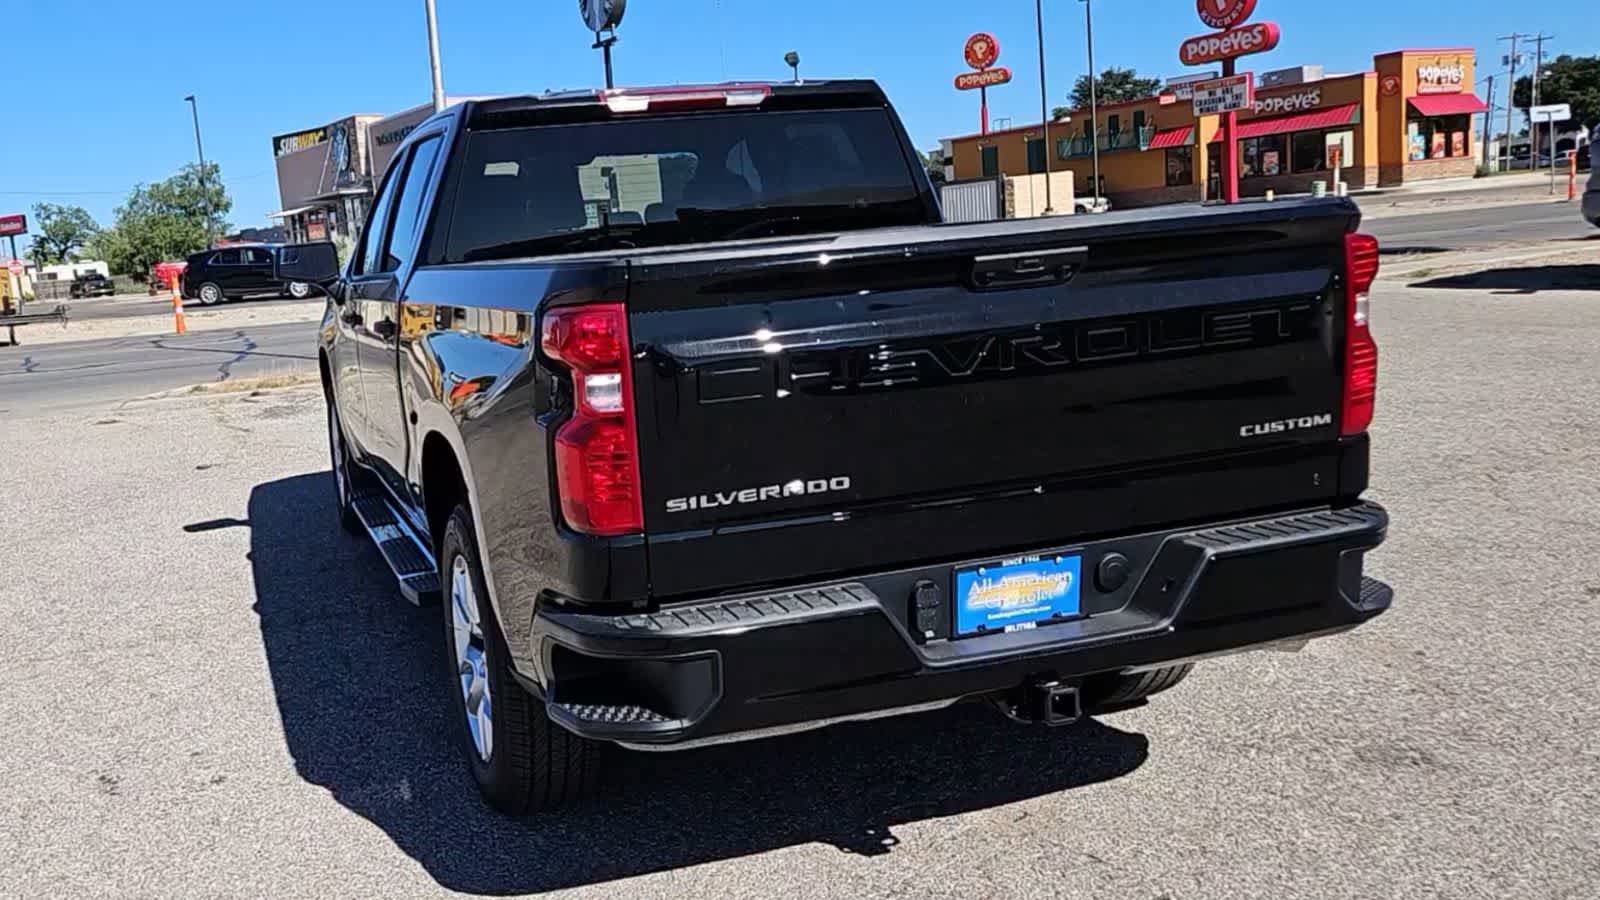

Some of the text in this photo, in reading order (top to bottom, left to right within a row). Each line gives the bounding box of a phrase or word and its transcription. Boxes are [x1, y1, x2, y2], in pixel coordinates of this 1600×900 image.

[1200, 2, 1244, 27] KITCHEN
[277, 130, 325, 157] SUBWAY
[697, 302, 1313, 405] CHEVROLET
[1240, 413, 1332, 437] CUSTOM
[666, 476, 851, 513] SILVERADO
